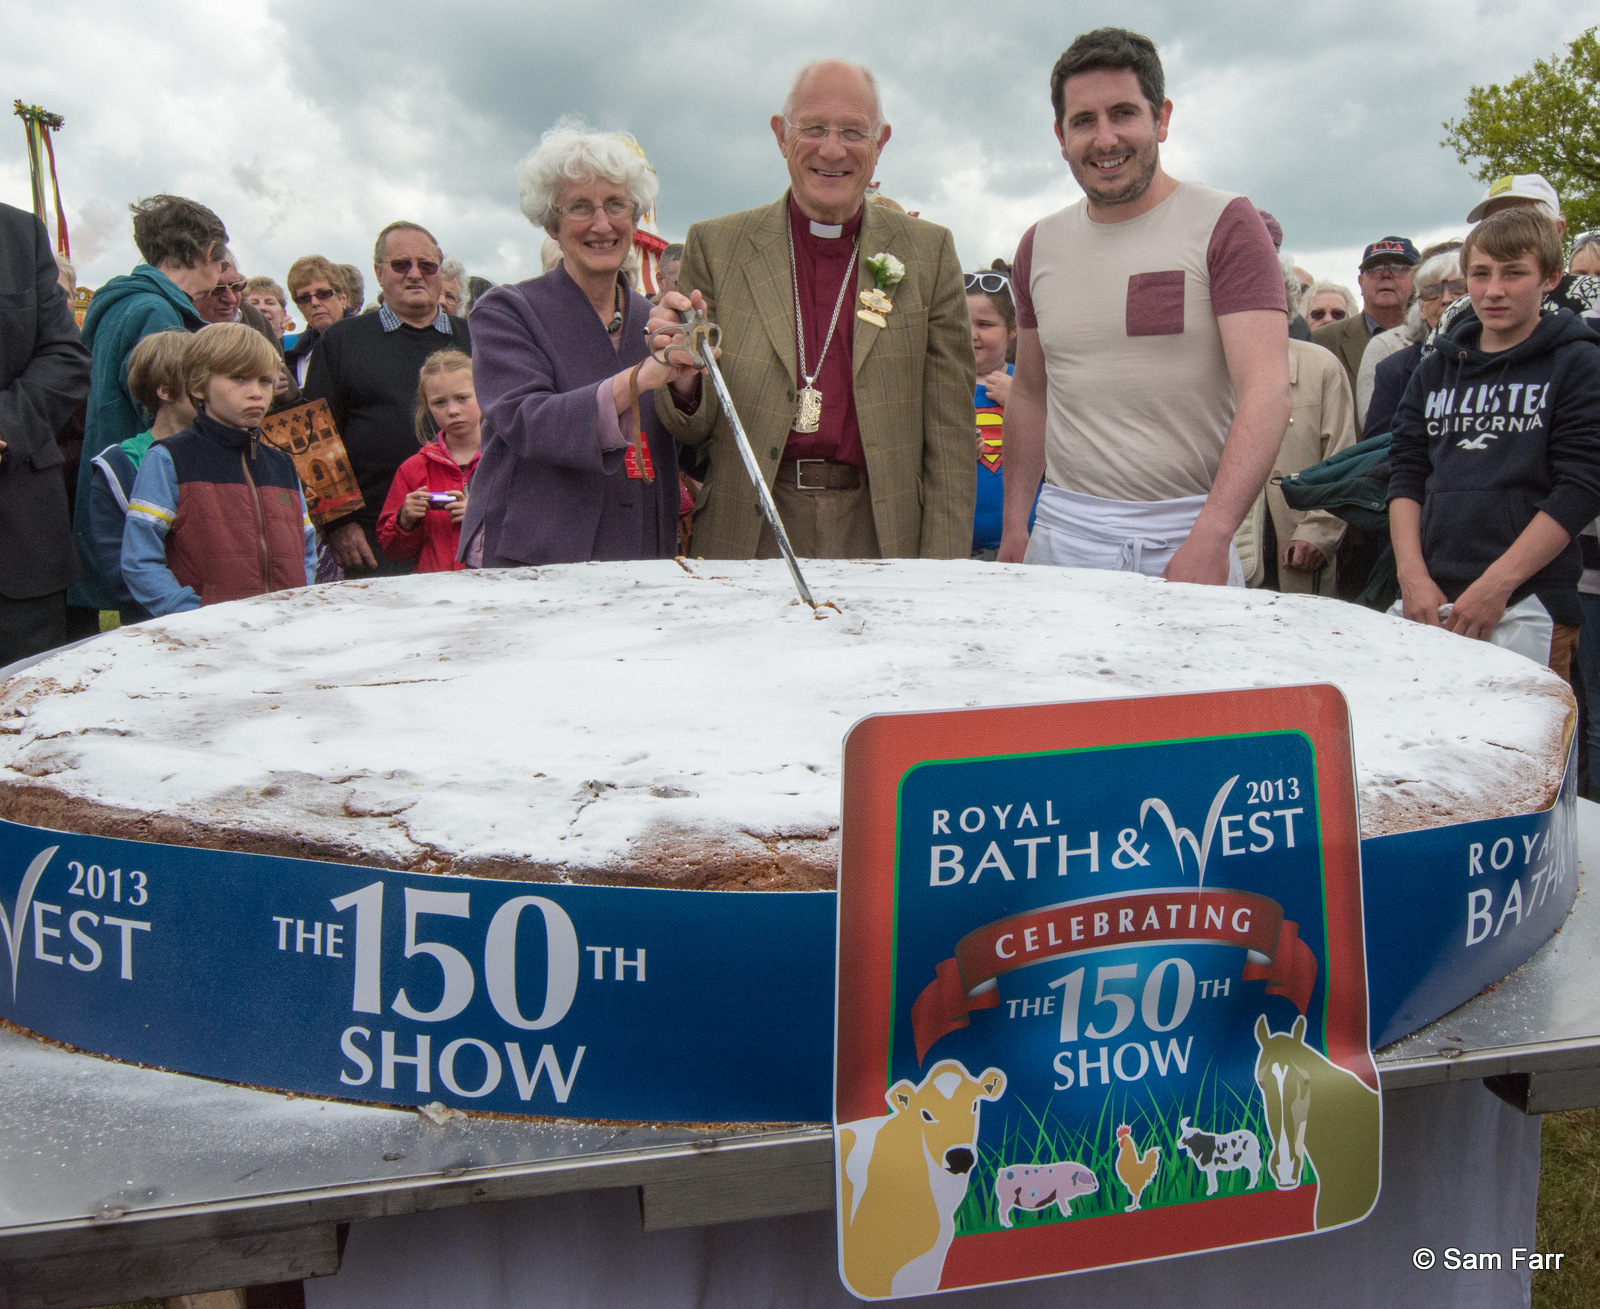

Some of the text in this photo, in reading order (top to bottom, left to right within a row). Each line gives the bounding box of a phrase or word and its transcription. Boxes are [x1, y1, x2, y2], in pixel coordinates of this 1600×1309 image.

[1245, 777, 1301, 804] 2013
[928, 774, 1305, 897] BATH & WEST
[931, 800, 1060, 835] ROYAL
[67, 861, 149, 906] 2013
[1465, 853, 1558, 947] BATH
[272, 916, 344, 960] THE
[994, 904, 1253, 960] CELEBRATING
[1006, 996, 1056, 1019] THE
[339, 1025, 587, 1104] SHOW
[1052, 1036, 1194, 1091] SHOW
